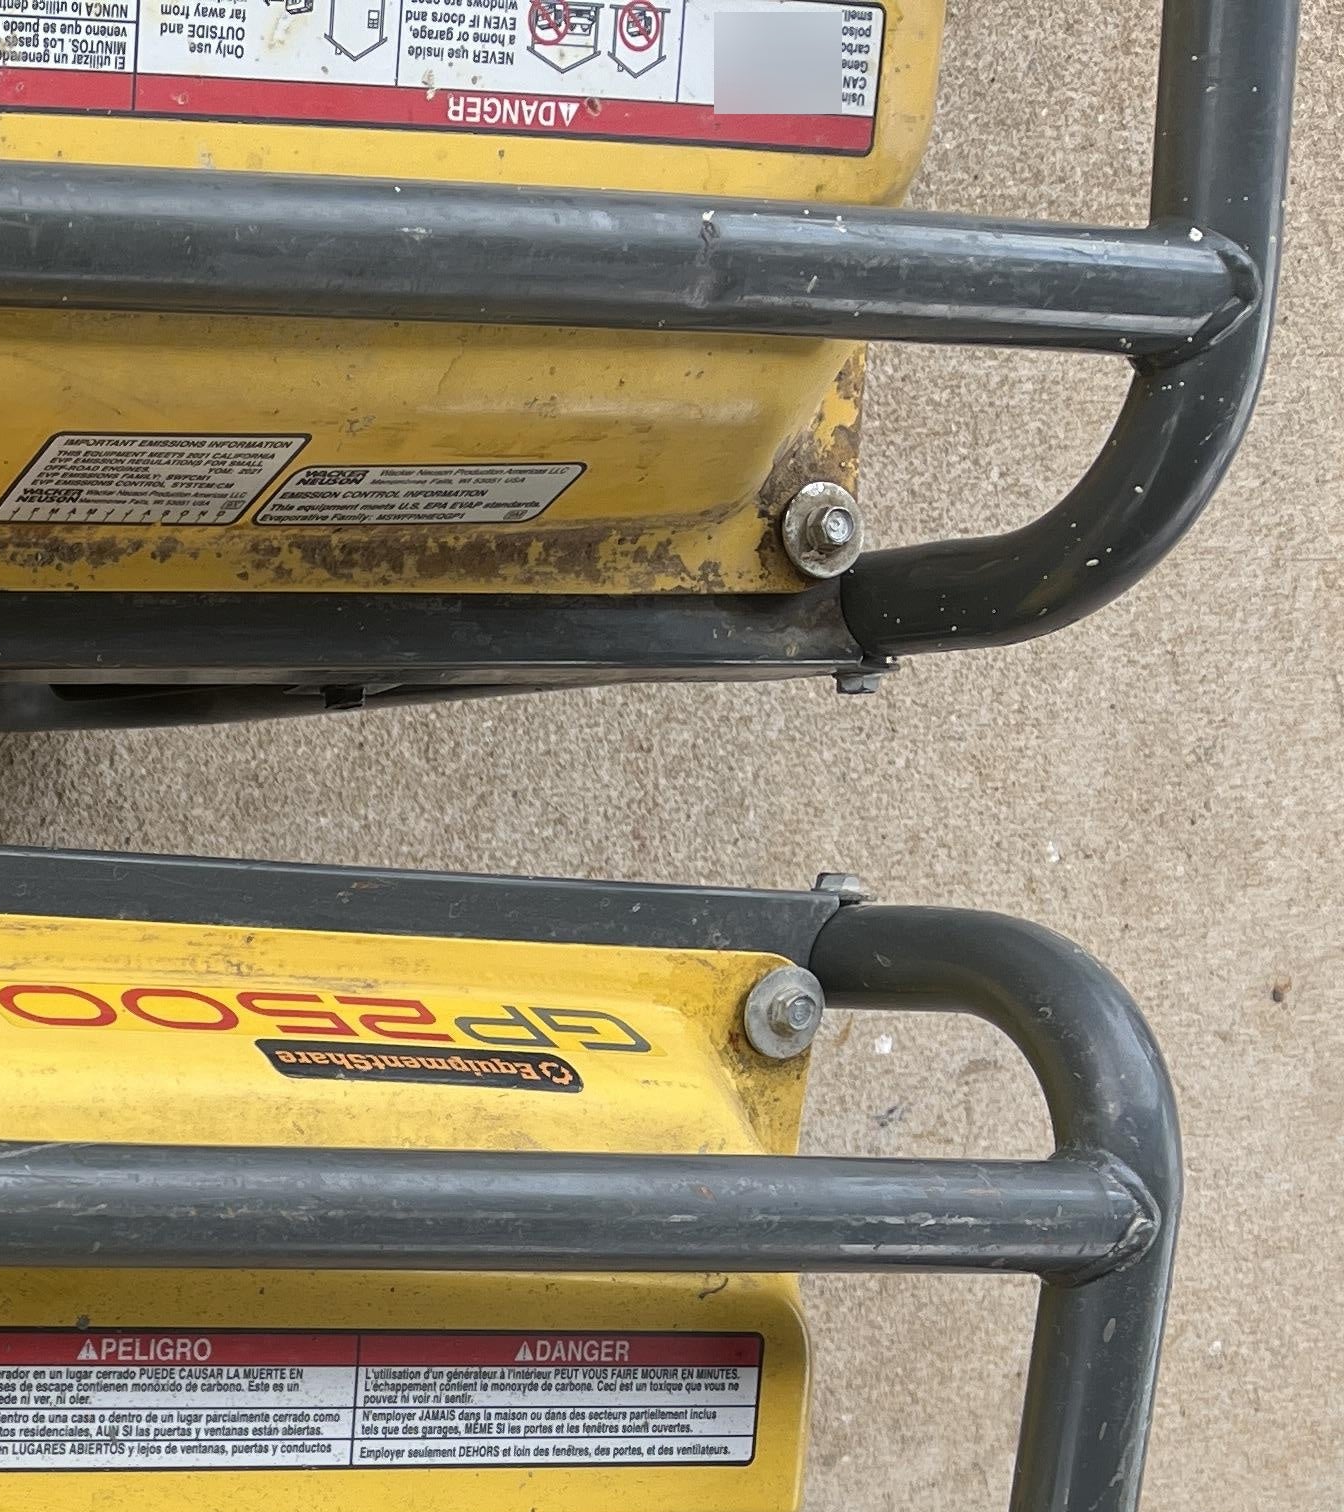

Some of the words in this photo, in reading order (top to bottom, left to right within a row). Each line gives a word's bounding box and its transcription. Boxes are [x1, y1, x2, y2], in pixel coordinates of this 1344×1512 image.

[160, 23, 183, 36] and
[187, 24, 245, 40] OUTSIDE
[189, 42, 206, 54] use
[211, 43, 243, 59] Only
[409, 44, 444, 58] inside
[448, 48, 469, 60] use
[473, 49, 514, 65] NEVER
[843, 76, 866, 89] CAN
[447, 95, 556, 127] DANGER
[64, 439, 135, 447] IMPORTANT
[137, 440, 205, 448] EMISSIONS
[208, 441, 292, 449] INFORMATION
[275, 1048, 541, 1082] EquipmentShare
[100, 1338, 212, 1361] PELIGRO
[534, 1338, 631, 1361] DANGER
